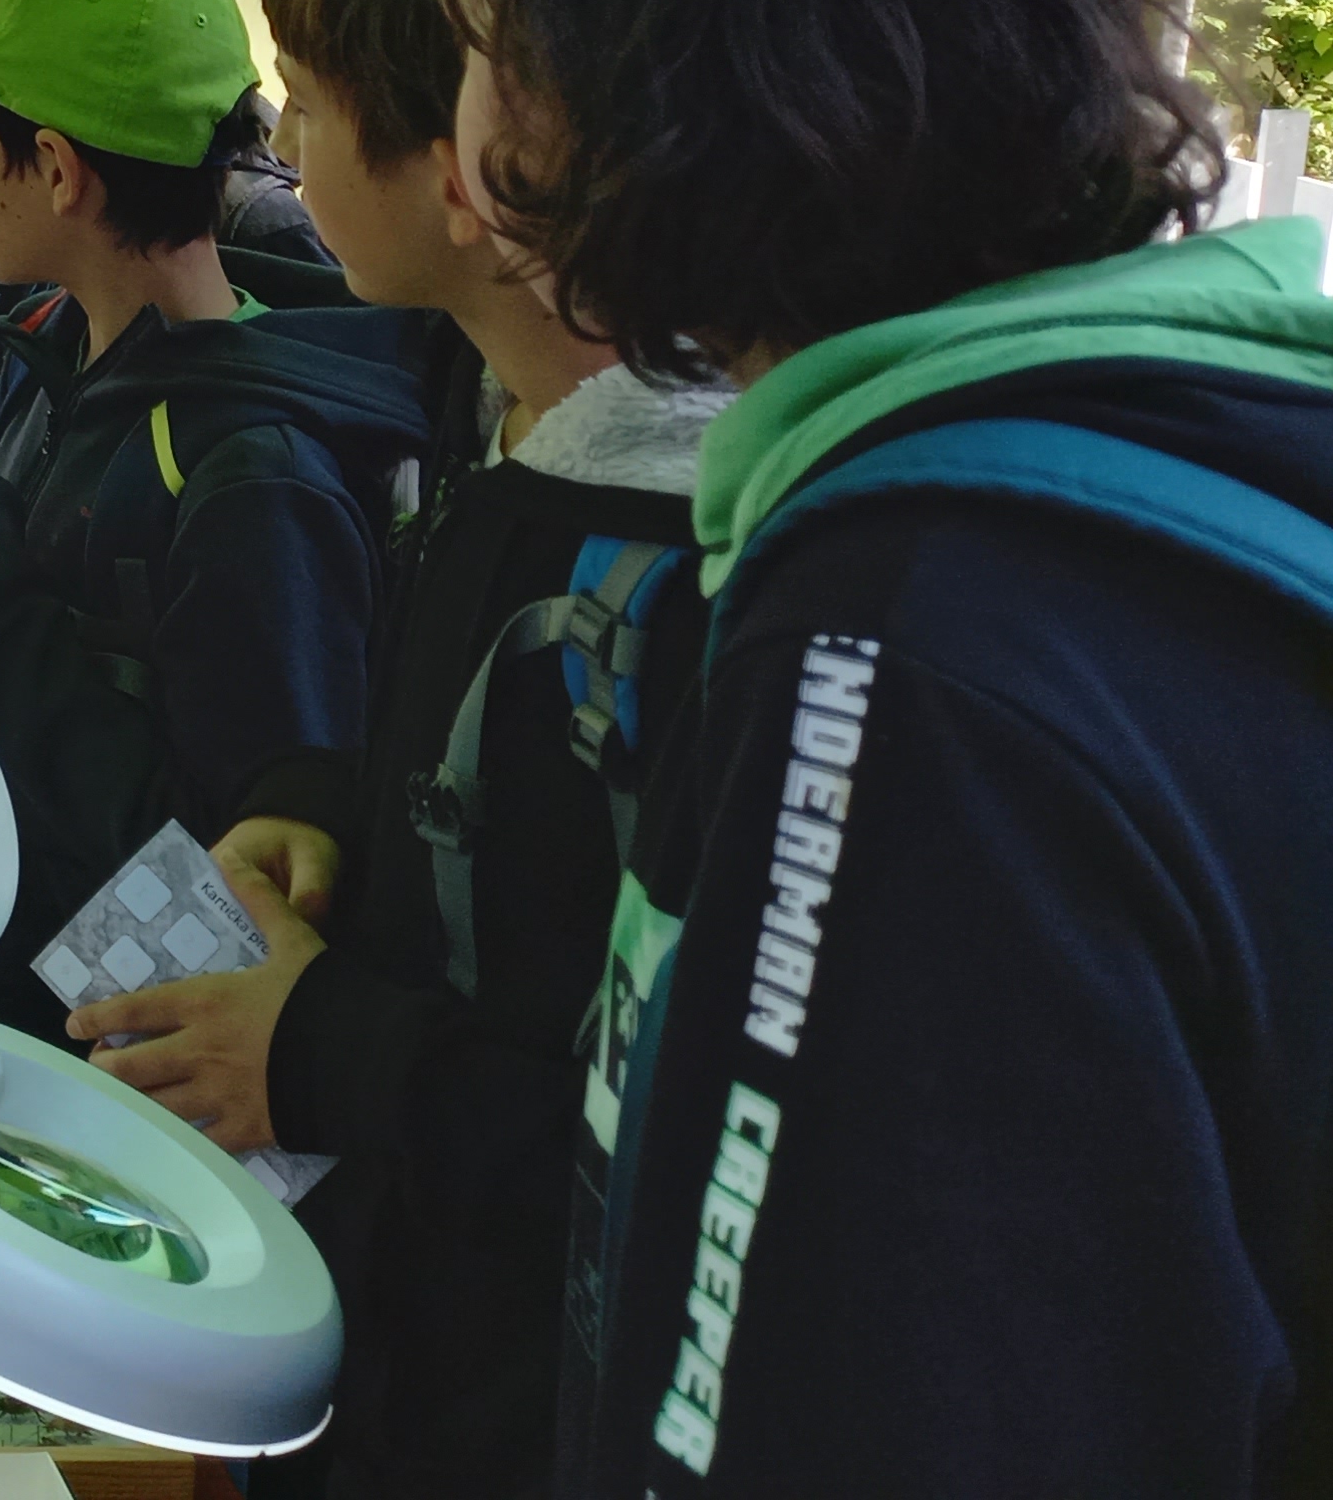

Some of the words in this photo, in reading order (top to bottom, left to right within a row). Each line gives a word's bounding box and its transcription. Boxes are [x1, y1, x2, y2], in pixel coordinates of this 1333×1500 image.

[200, 881, 249, 934] Kartička
[744, 633, 881, 1059] NDERMAN
[653, 1080, 781, 1477] CREEPER
